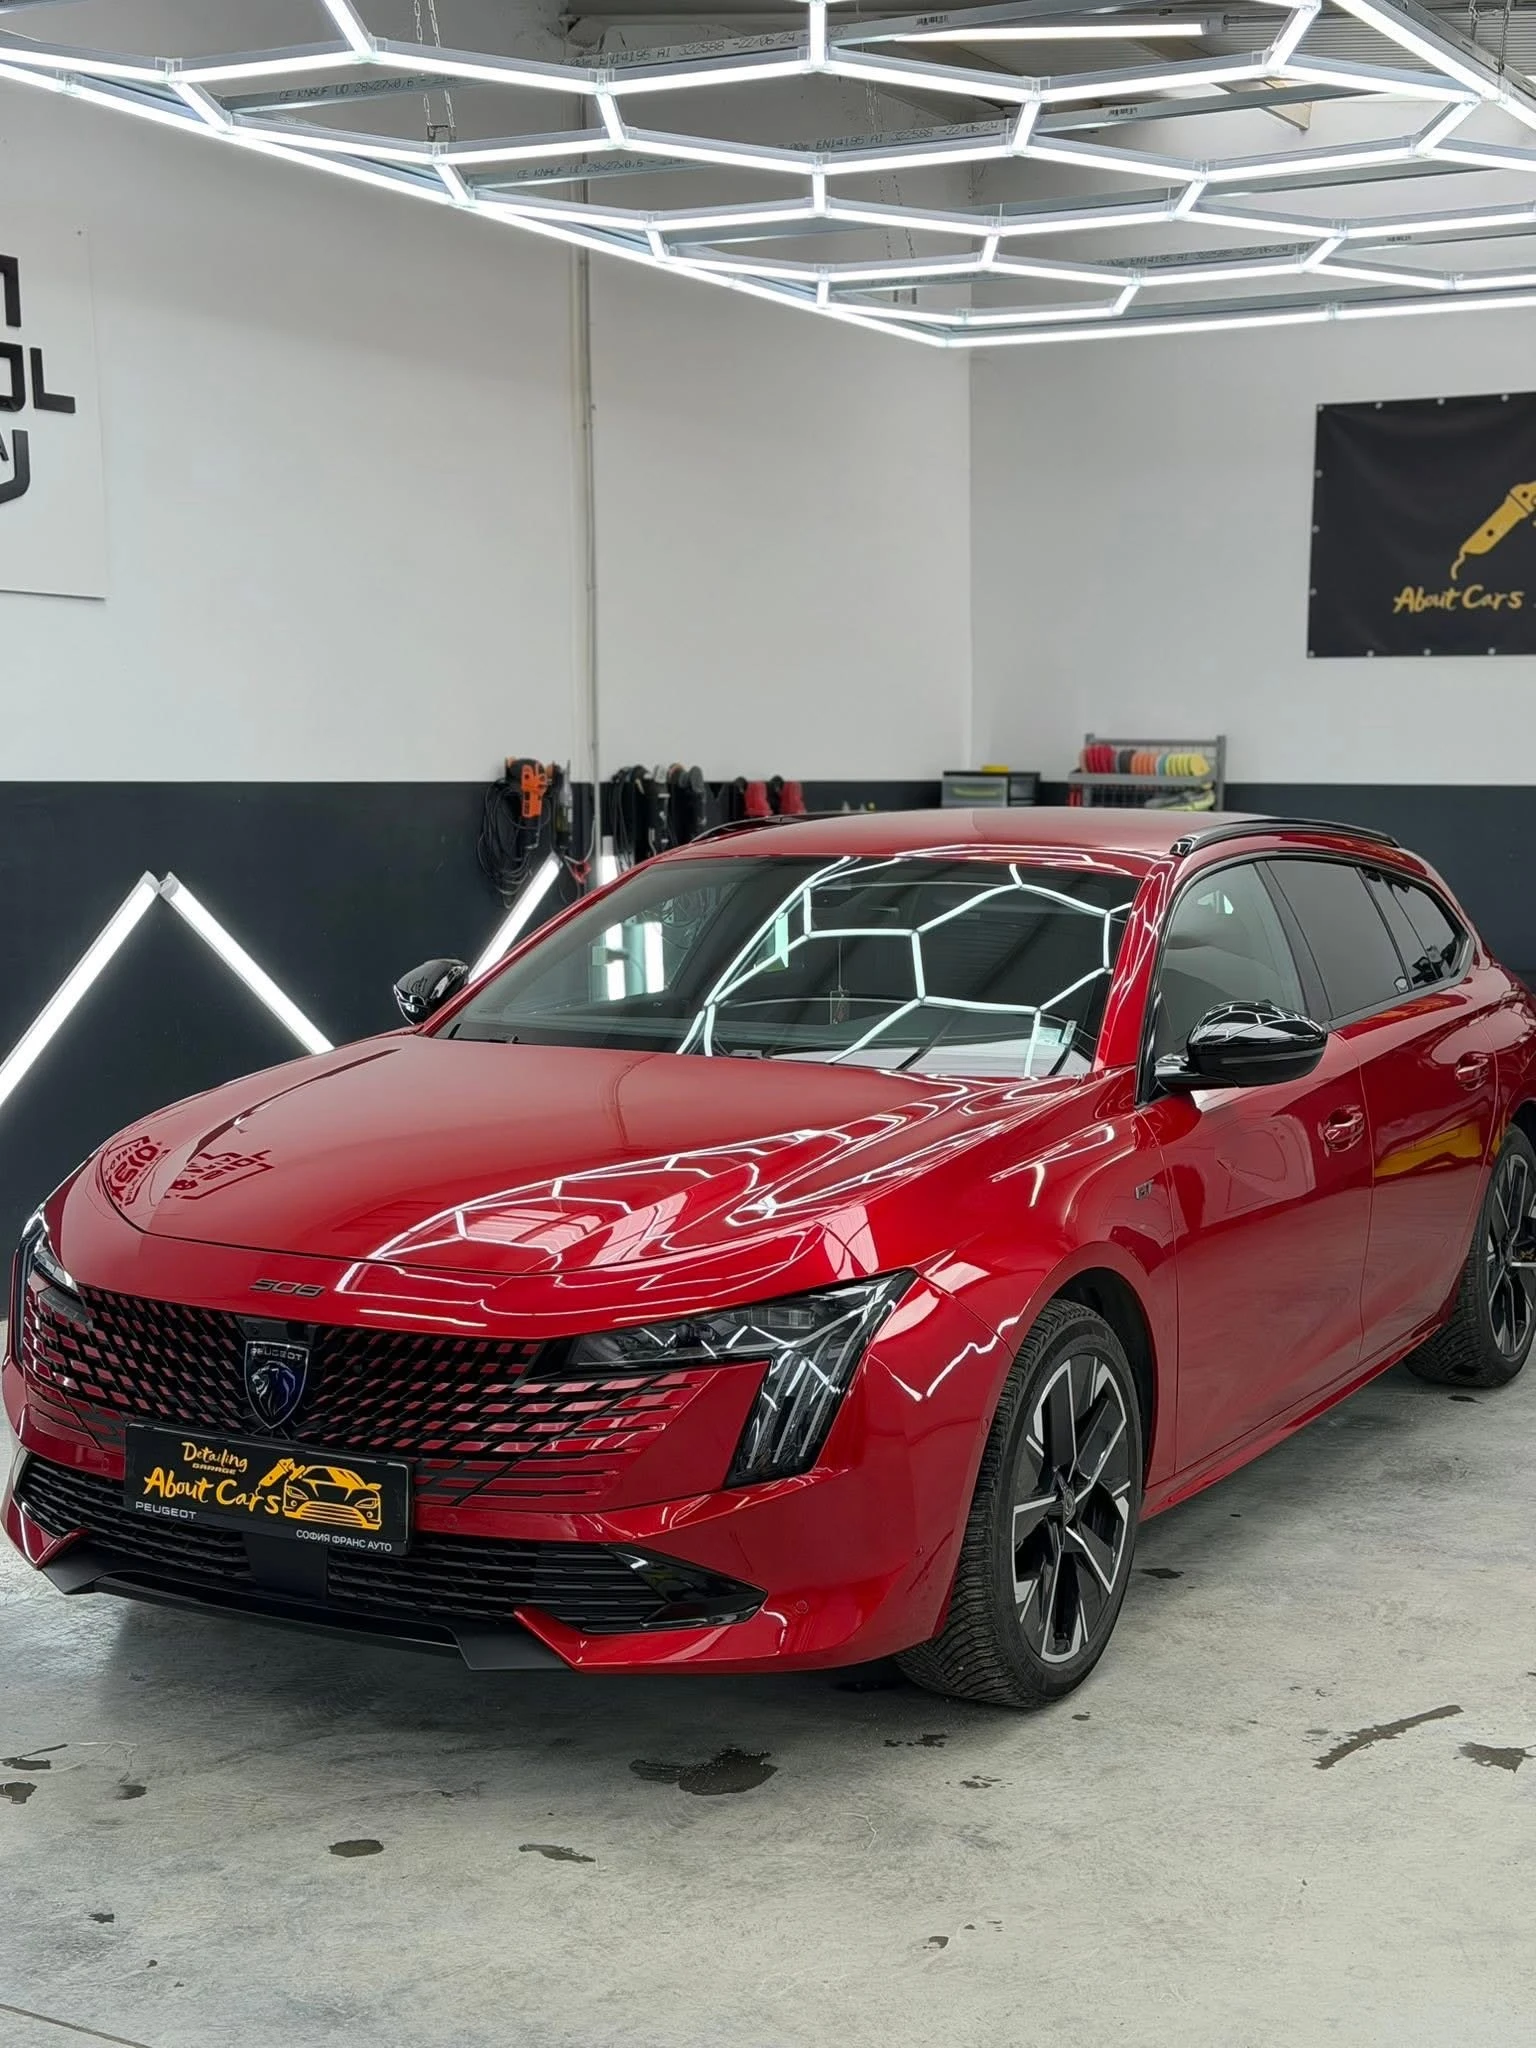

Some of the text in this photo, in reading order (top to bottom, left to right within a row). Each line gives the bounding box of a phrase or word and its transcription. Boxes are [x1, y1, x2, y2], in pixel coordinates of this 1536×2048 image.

[1393, 584, 1525, 613] About Cars
[250, 1279, 326, 1298] 508
[181, 1441, 248, 1473] Detailing
[192, 1462, 236, 1476] GARAGE
[143, 1466, 281, 1514] About Cars
[135, 1501, 197, 1520] PEUGEOT
[296, 1529, 392, 1553] СОФИЯ ФРАНС АУТО
